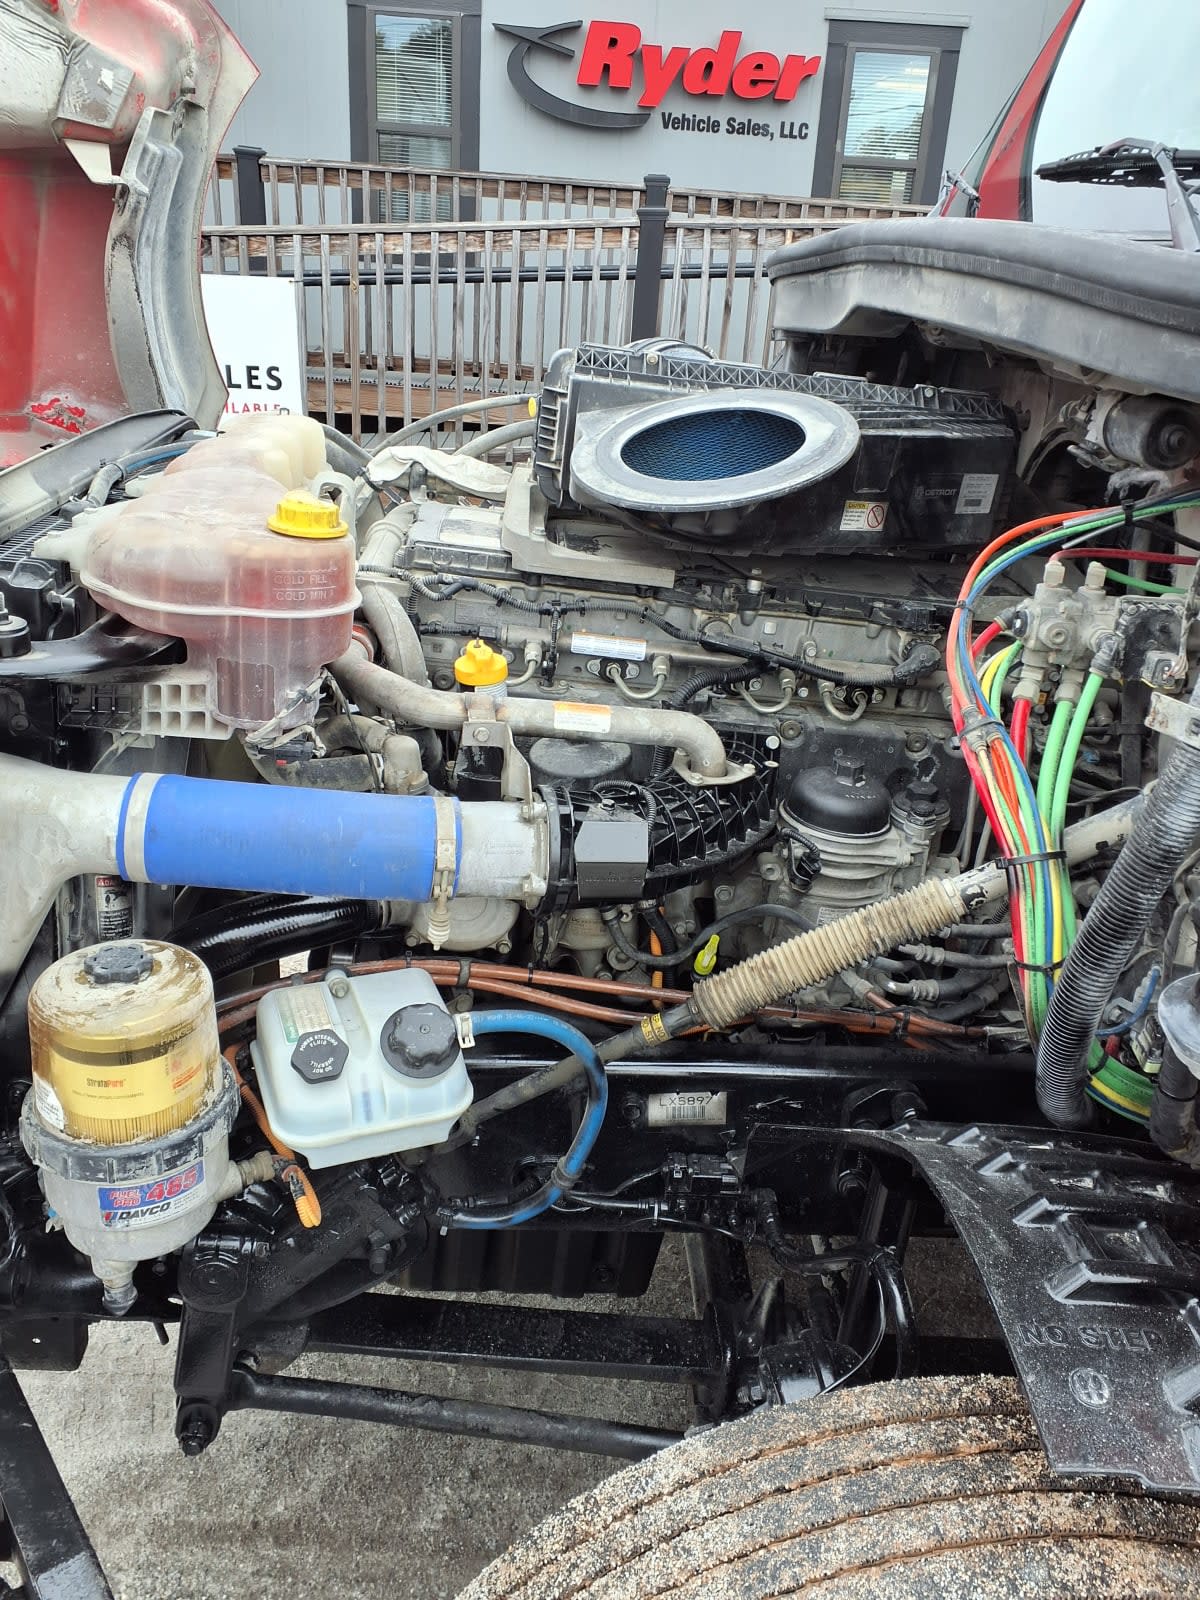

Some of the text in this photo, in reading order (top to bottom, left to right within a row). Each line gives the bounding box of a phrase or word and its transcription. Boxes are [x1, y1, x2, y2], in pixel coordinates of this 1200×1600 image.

[577, 20, 821, 108] Ryder
[661, 112, 809, 141] Vehicle Sales, LLC
[275, 591, 306, 601] COLD
[309, 1040, 328, 1048] FLUID
[118, 1202, 171, 1220] DAVCO
[1016, 1320, 1164, 1351] NO STEP
